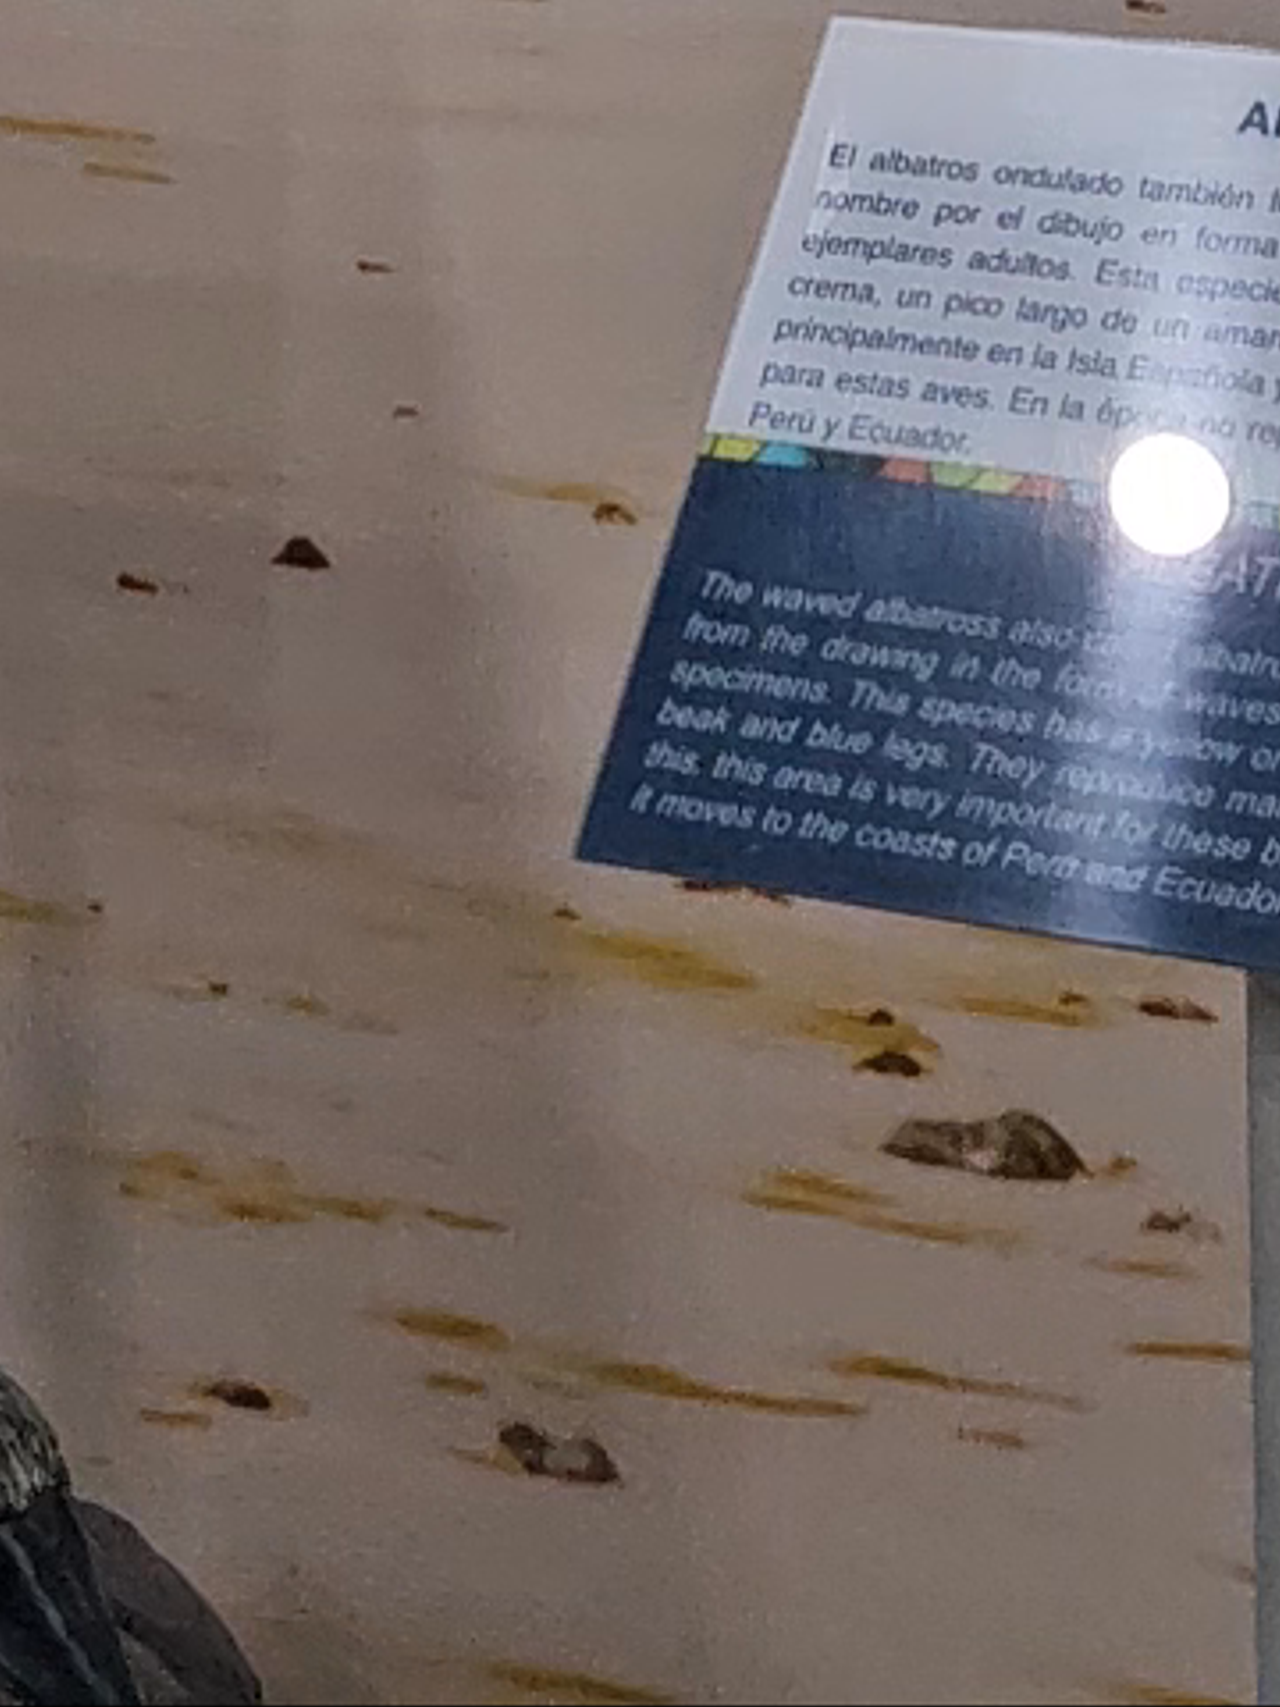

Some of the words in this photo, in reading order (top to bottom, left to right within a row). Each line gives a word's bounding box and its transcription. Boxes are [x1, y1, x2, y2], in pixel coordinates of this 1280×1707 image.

[828, 142, 858, 170] El
[868, 148, 980, 184] albatros
[991, 164, 1126, 198] ondulado
[1138, 176, 1256, 211] también
[801, 228, 954, 270] ejemplares
[812, 189, 921, 221] nombre
[932, 202, 983, 228] por
[995, 204, 1026, 231] el
[1036, 209, 1125, 246] dibujo
[1139, 227, 1179, 248] en
[1195, 225, 1280, 260] forma
[895, 288, 933, 310] un
[941, 290, 1006, 320] pico
[1015, 295, 1089, 334] largo
[1099, 307, 1139, 336] de
[772, 315, 981, 362] principalmente
[986, 342, 1025, 367] en
[1030, 341, 1059, 371] la
[1066, 346, 1119, 381] Isla
[758, 361, 826, 389] para
[833, 371, 911, 401] estas
[1007, 385, 1050, 417] En
[1057, 392, 1086, 423] la
[821, 417, 842, 442] y
